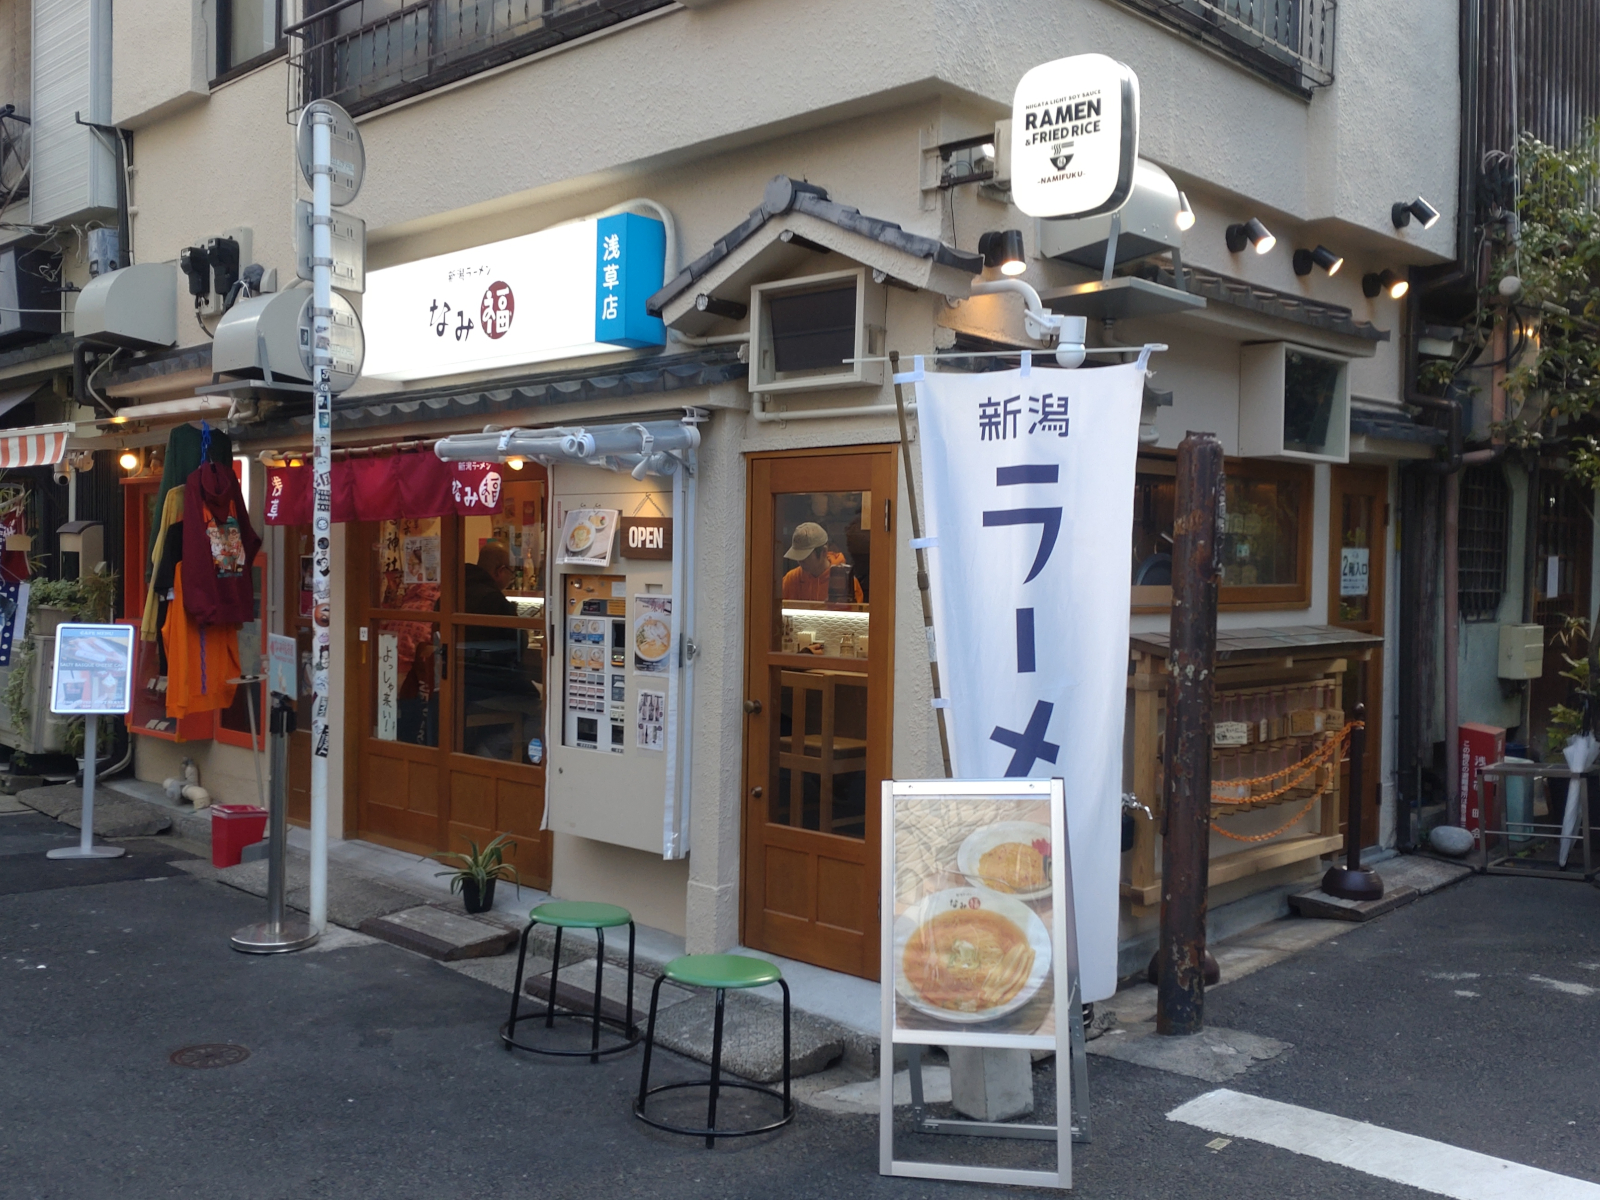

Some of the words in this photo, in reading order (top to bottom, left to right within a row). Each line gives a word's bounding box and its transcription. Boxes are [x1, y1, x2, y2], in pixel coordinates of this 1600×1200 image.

[1025, 98, 1101, 131] RAMEN
[1050, 96, 1067, 105] LIGHT
[1071, 120, 1101, 138] RICE
[602, 234, 620, 320] 浅草店
[979, 393, 1069, 441] 新潟
[628, 526, 663, 549] OPEN
